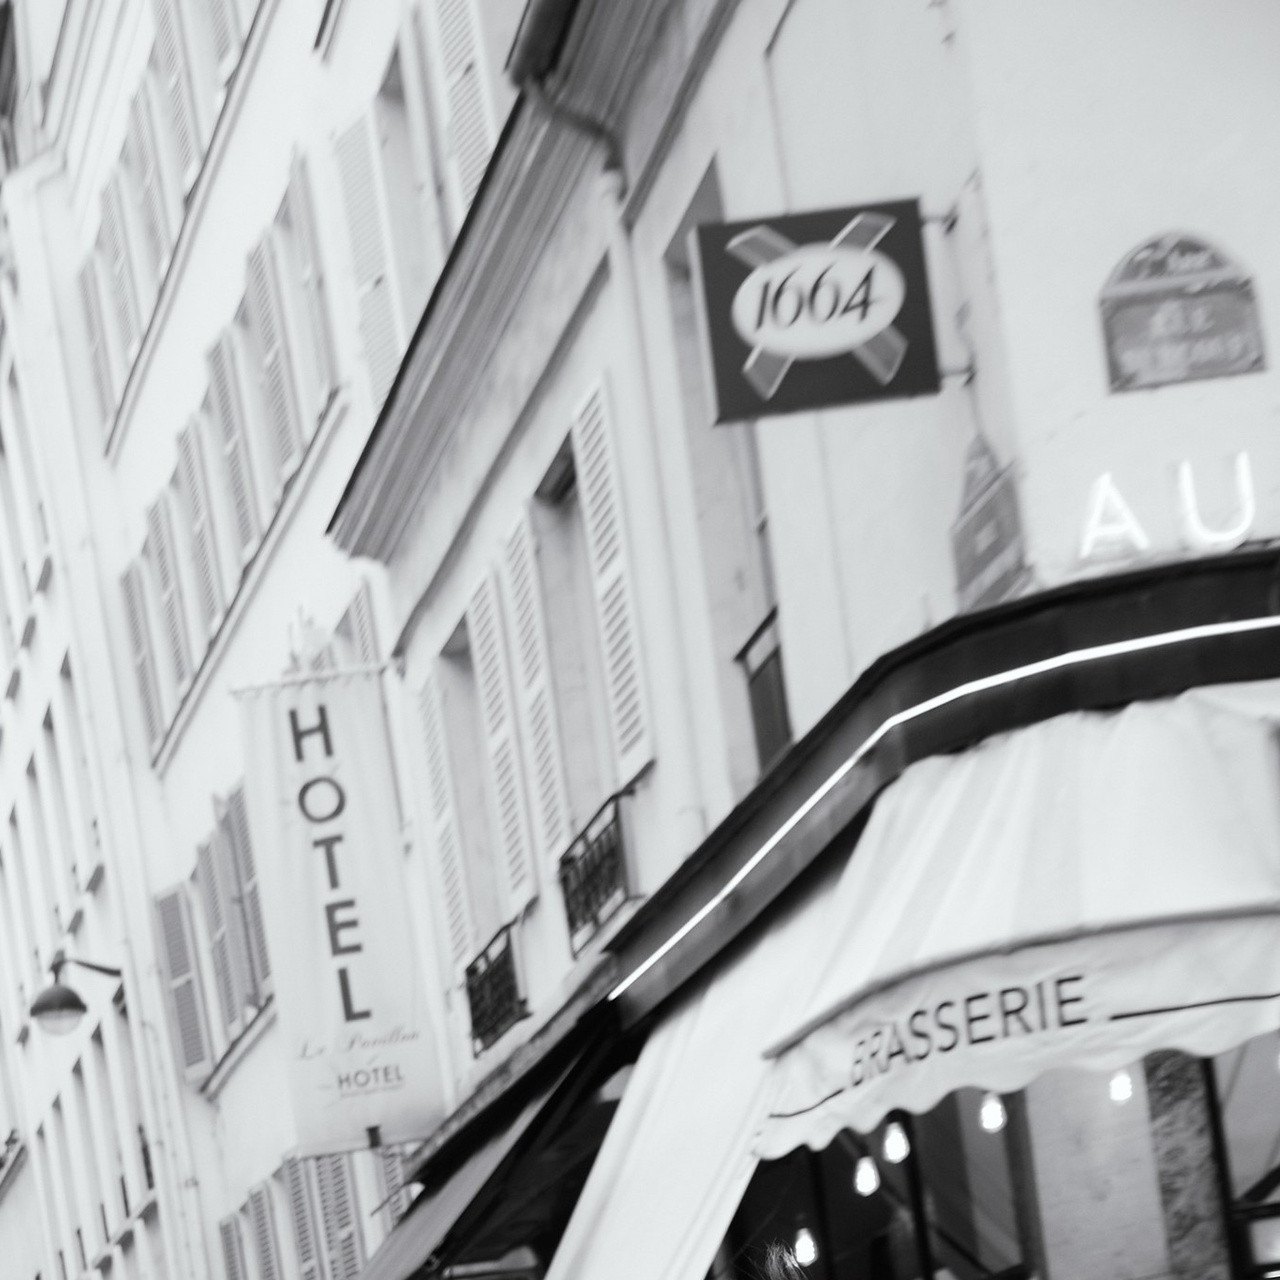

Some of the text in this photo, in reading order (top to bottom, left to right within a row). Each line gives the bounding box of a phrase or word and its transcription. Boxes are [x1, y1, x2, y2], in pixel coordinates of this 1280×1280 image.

[754, 262, 883, 332] 1664
[1079, 449, 1255, 558] AU
[289, 704, 372, 1022] HOTEL
[337, 1064, 404, 1089] HOTEL
[851, 975, 1088, 1087] BRASSERIE
